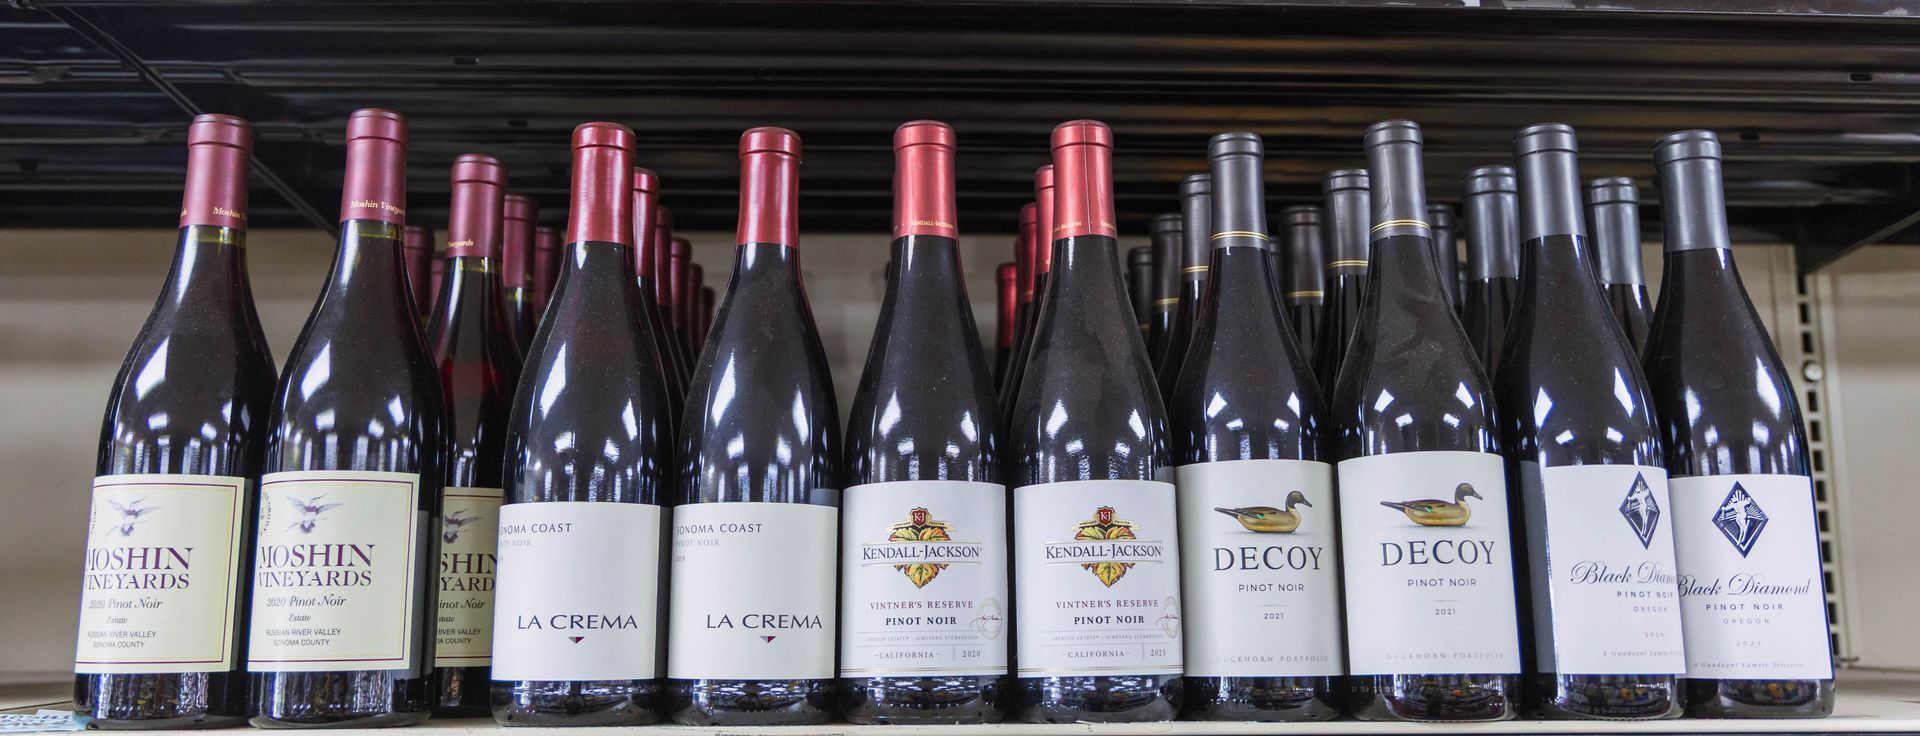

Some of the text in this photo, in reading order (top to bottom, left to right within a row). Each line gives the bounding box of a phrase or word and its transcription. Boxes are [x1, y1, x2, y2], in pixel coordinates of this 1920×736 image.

[350, 199, 378, 209] Moshin
[213, 206, 241, 218] Moshin
[499, 523, 572, 536] ONOMA COAST
[676, 523, 763, 536] SONOMA COAST
[697, 538, 720, 546] NOIR
[258, 543, 375, 569] MOSHIN
[863, 544, 980, 561] KENDALL-JACKSON
[1046, 543, 1162, 560] KENDALL-JACKSON
[1214, 545, 1323, 571] DECOY
[1380, 539, 1496, 567] DECOY
[440, 552, 498, 574] SHIN
[258, 570, 372, 588] VINEYARDS
[1570, 560, 1632, 585] Black
[1238, 583, 1305, 592] PINOT NOIR
[1408, 578, 1477, 587] PINOT NOIR
[1677, 572, 1811, 597] Black Diamond
[107, 598, 133, 609] Pinot
[133, 596, 163, 609] Noir
[267, 593, 347, 607] 2020 Pinot Noir
[439, 597, 486, 609] inot Noir
[870, 600, 974, 610] VINTNER'S RESERVE
[1056, 599, 1159, 609] VINTNER'S RESERVE
[1706, 603, 1783, 611] PINOT NOIR
[107, 616, 128, 625] Estate
[288, 613, 311, 622] Estate
[518, 614, 638, 630] LA CREMA
[707, 613, 822, 629] LA CREMA
[886, 616, 957, 626] PINOT NOIR
[1074, 615, 1145, 625] PINOT NOIR
[313, 628, 342, 636] VALLEY
